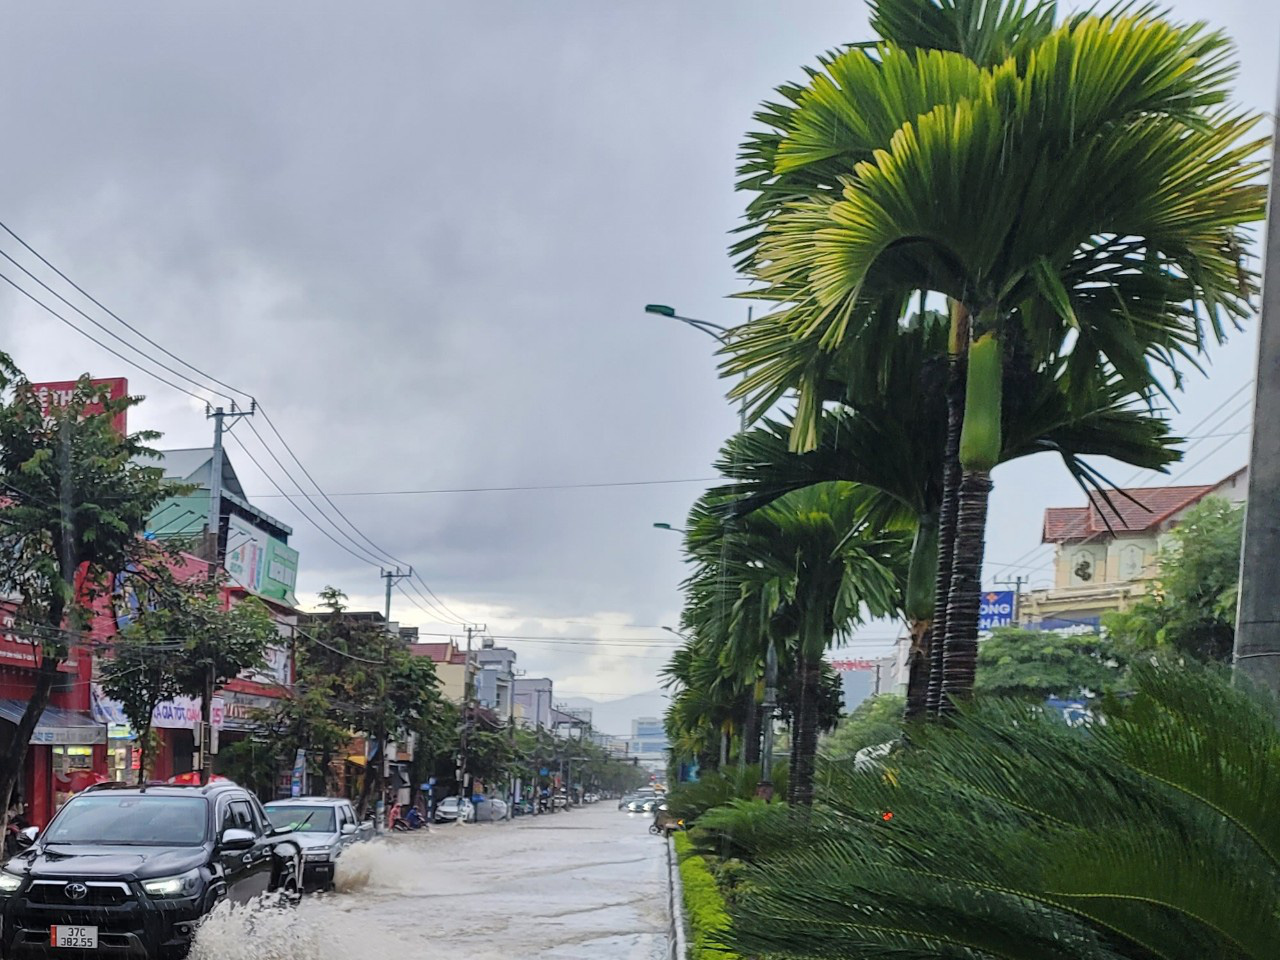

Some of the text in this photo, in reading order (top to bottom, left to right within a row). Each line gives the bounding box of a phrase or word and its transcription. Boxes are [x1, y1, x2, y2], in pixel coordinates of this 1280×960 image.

[980, 603, 1011, 615] ONG
[67, 927, 86, 937] 37C
[60, 937, 93, 948] 382.55
